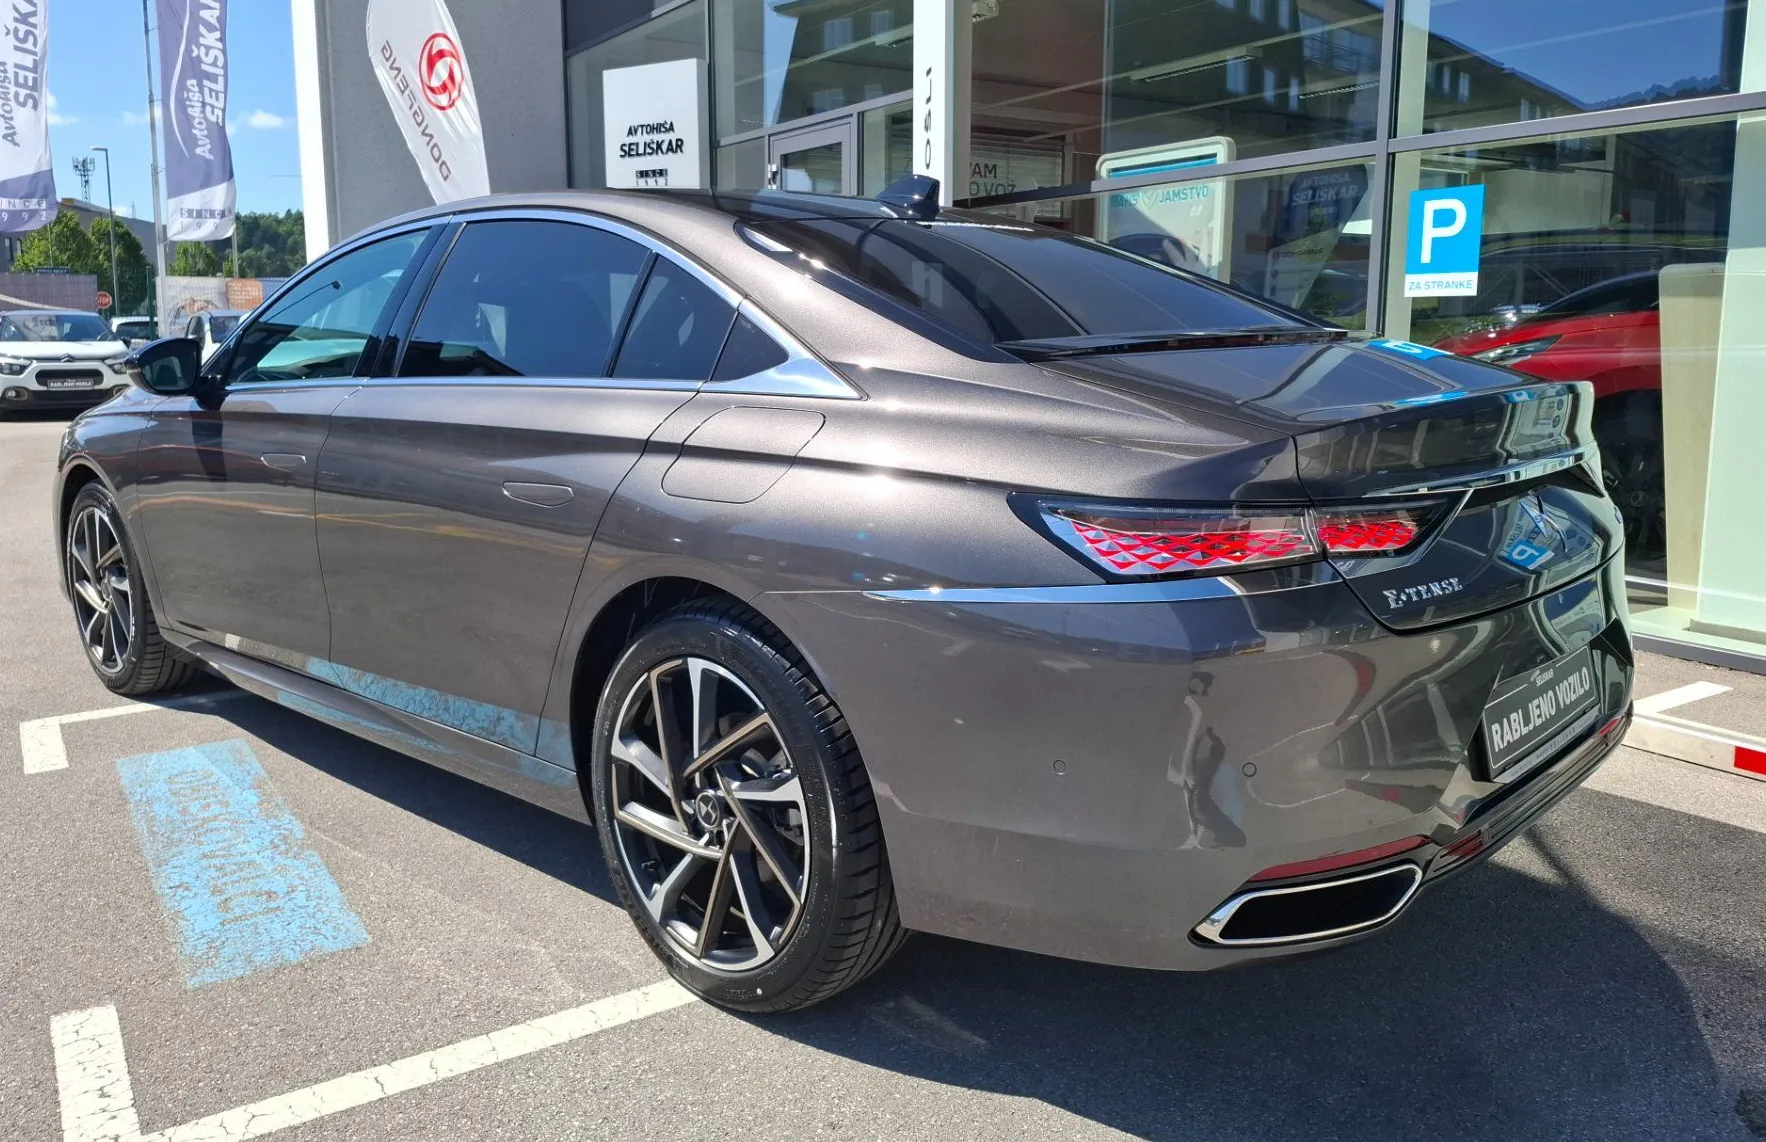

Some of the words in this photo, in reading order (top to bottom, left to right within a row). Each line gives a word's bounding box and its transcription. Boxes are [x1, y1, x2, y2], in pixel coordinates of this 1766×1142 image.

[626, 120, 675, 137] AVTOHIŠA
[619, 138, 684, 158] SELIŠKAR
[636, 168, 668, 178] SINCE
[970, 162, 997, 179] AM
[1159, 185, 1210, 204] JAMSTVO
[1420, 198, 1467, 264] P
[1408, 281, 1421, 290] ZA
[1424, 280, 1473, 290] STRANKE
[1491, 689, 1556, 753] RABLJENO
[1555, 666, 1590, 710] VOZILO
